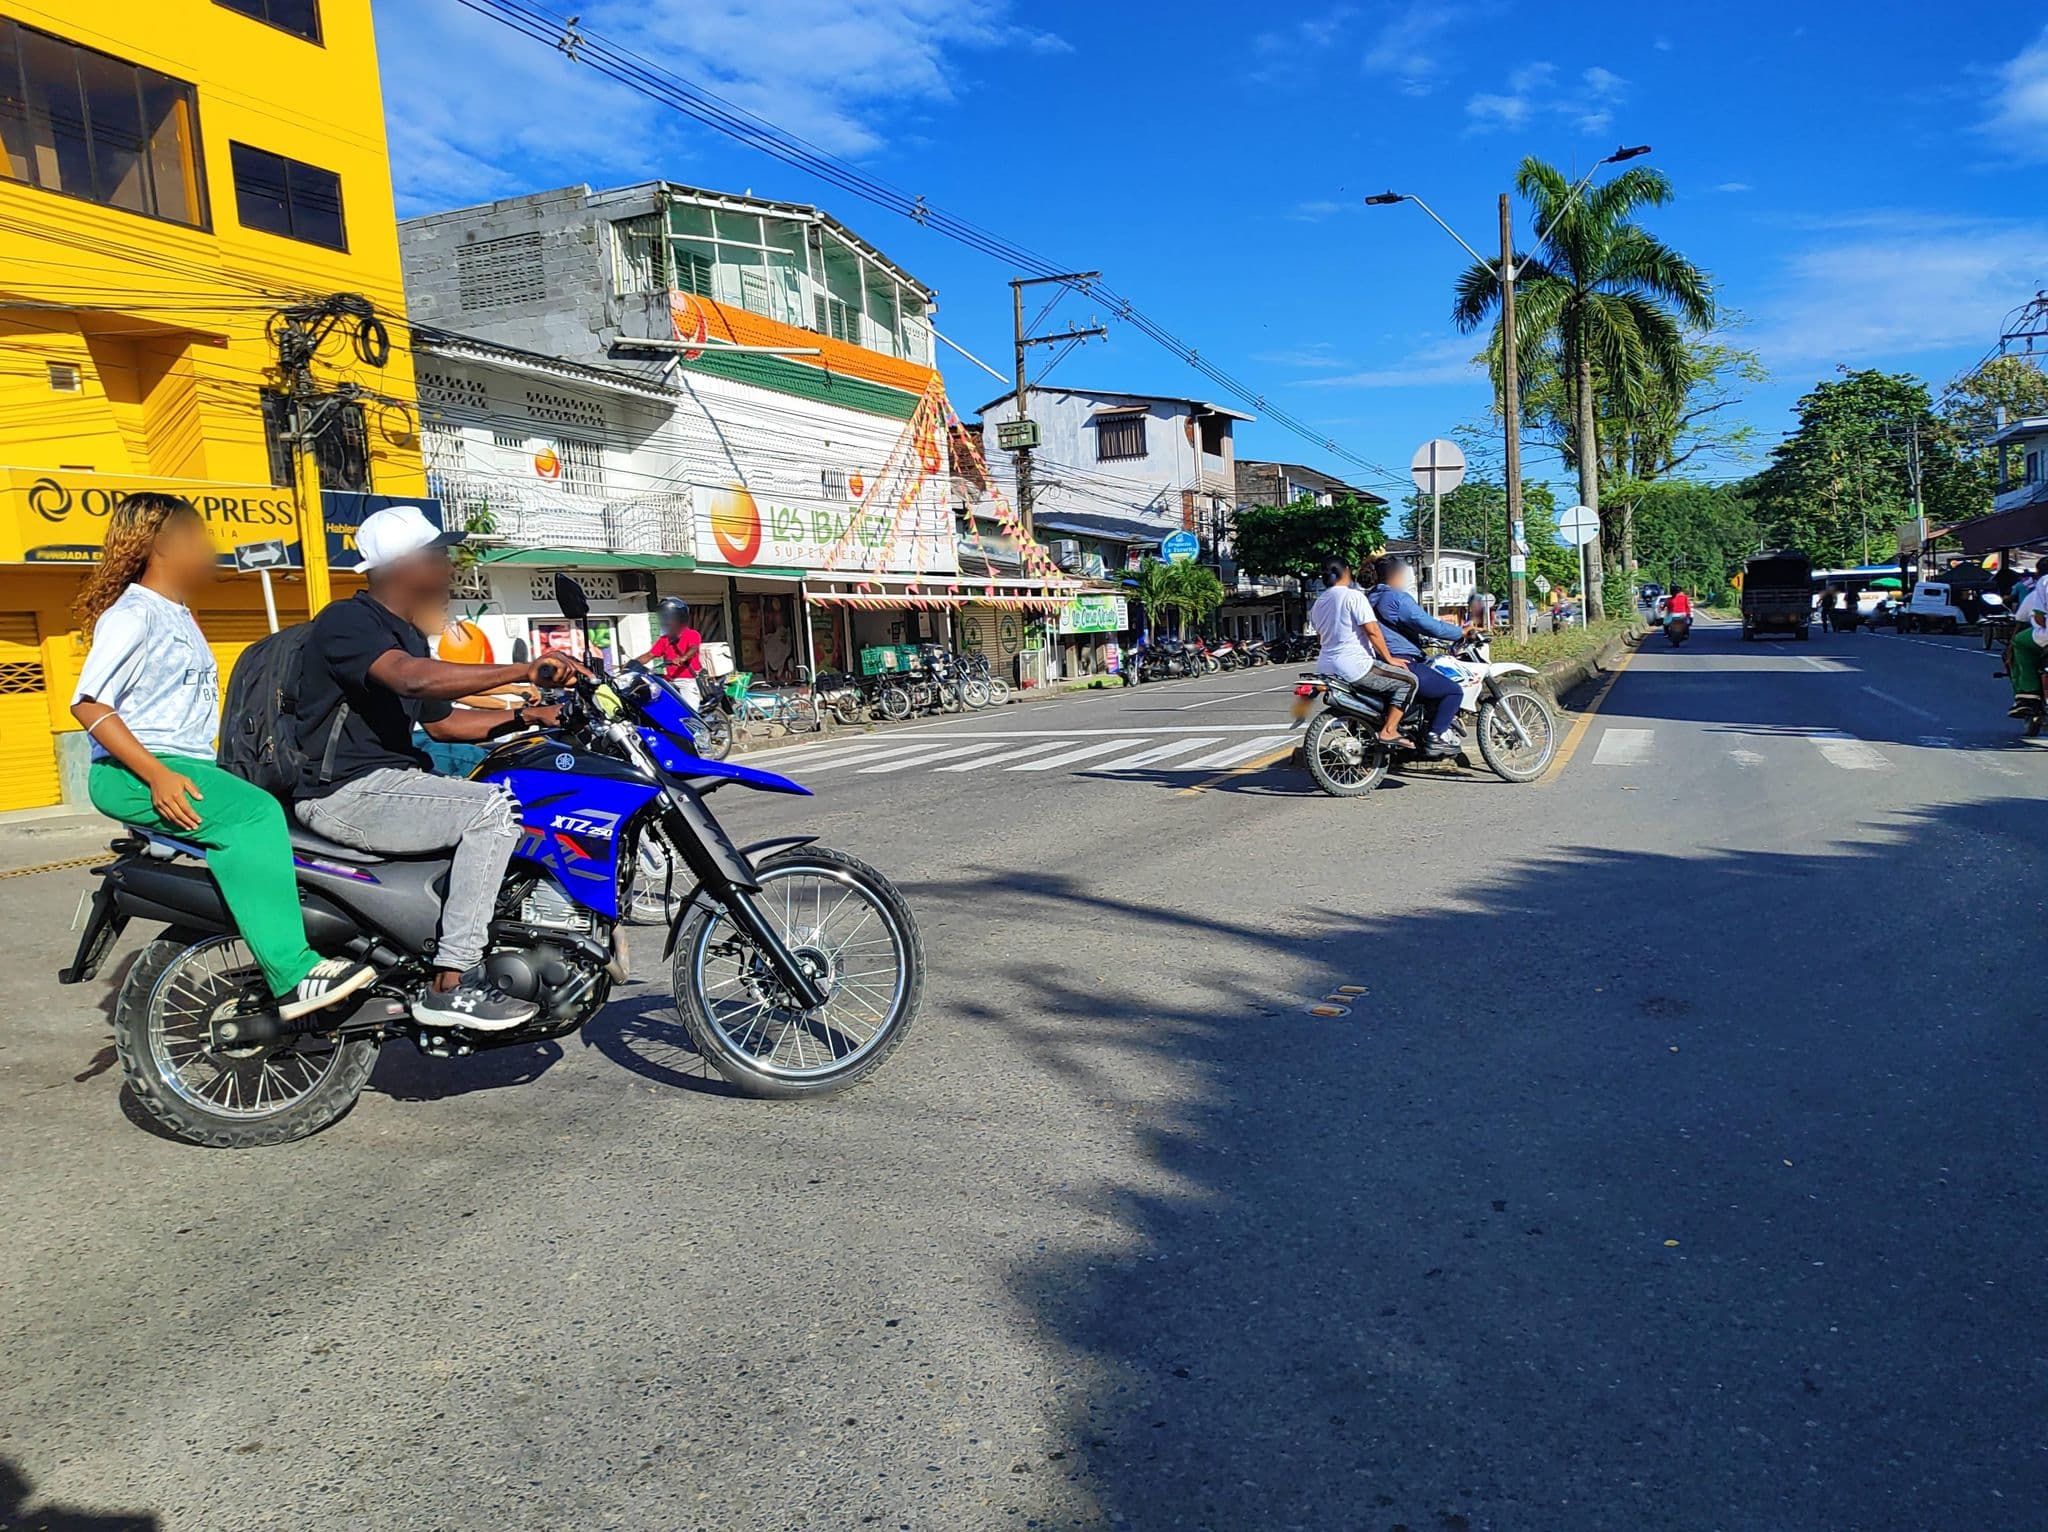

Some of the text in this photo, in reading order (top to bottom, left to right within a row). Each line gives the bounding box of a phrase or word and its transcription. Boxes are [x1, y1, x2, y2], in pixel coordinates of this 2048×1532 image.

[770, 506, 804, 542] LOS
[775, 545, 896, 563] SUPERERCAO
[550, 815, 613, 837] XTZ 250
